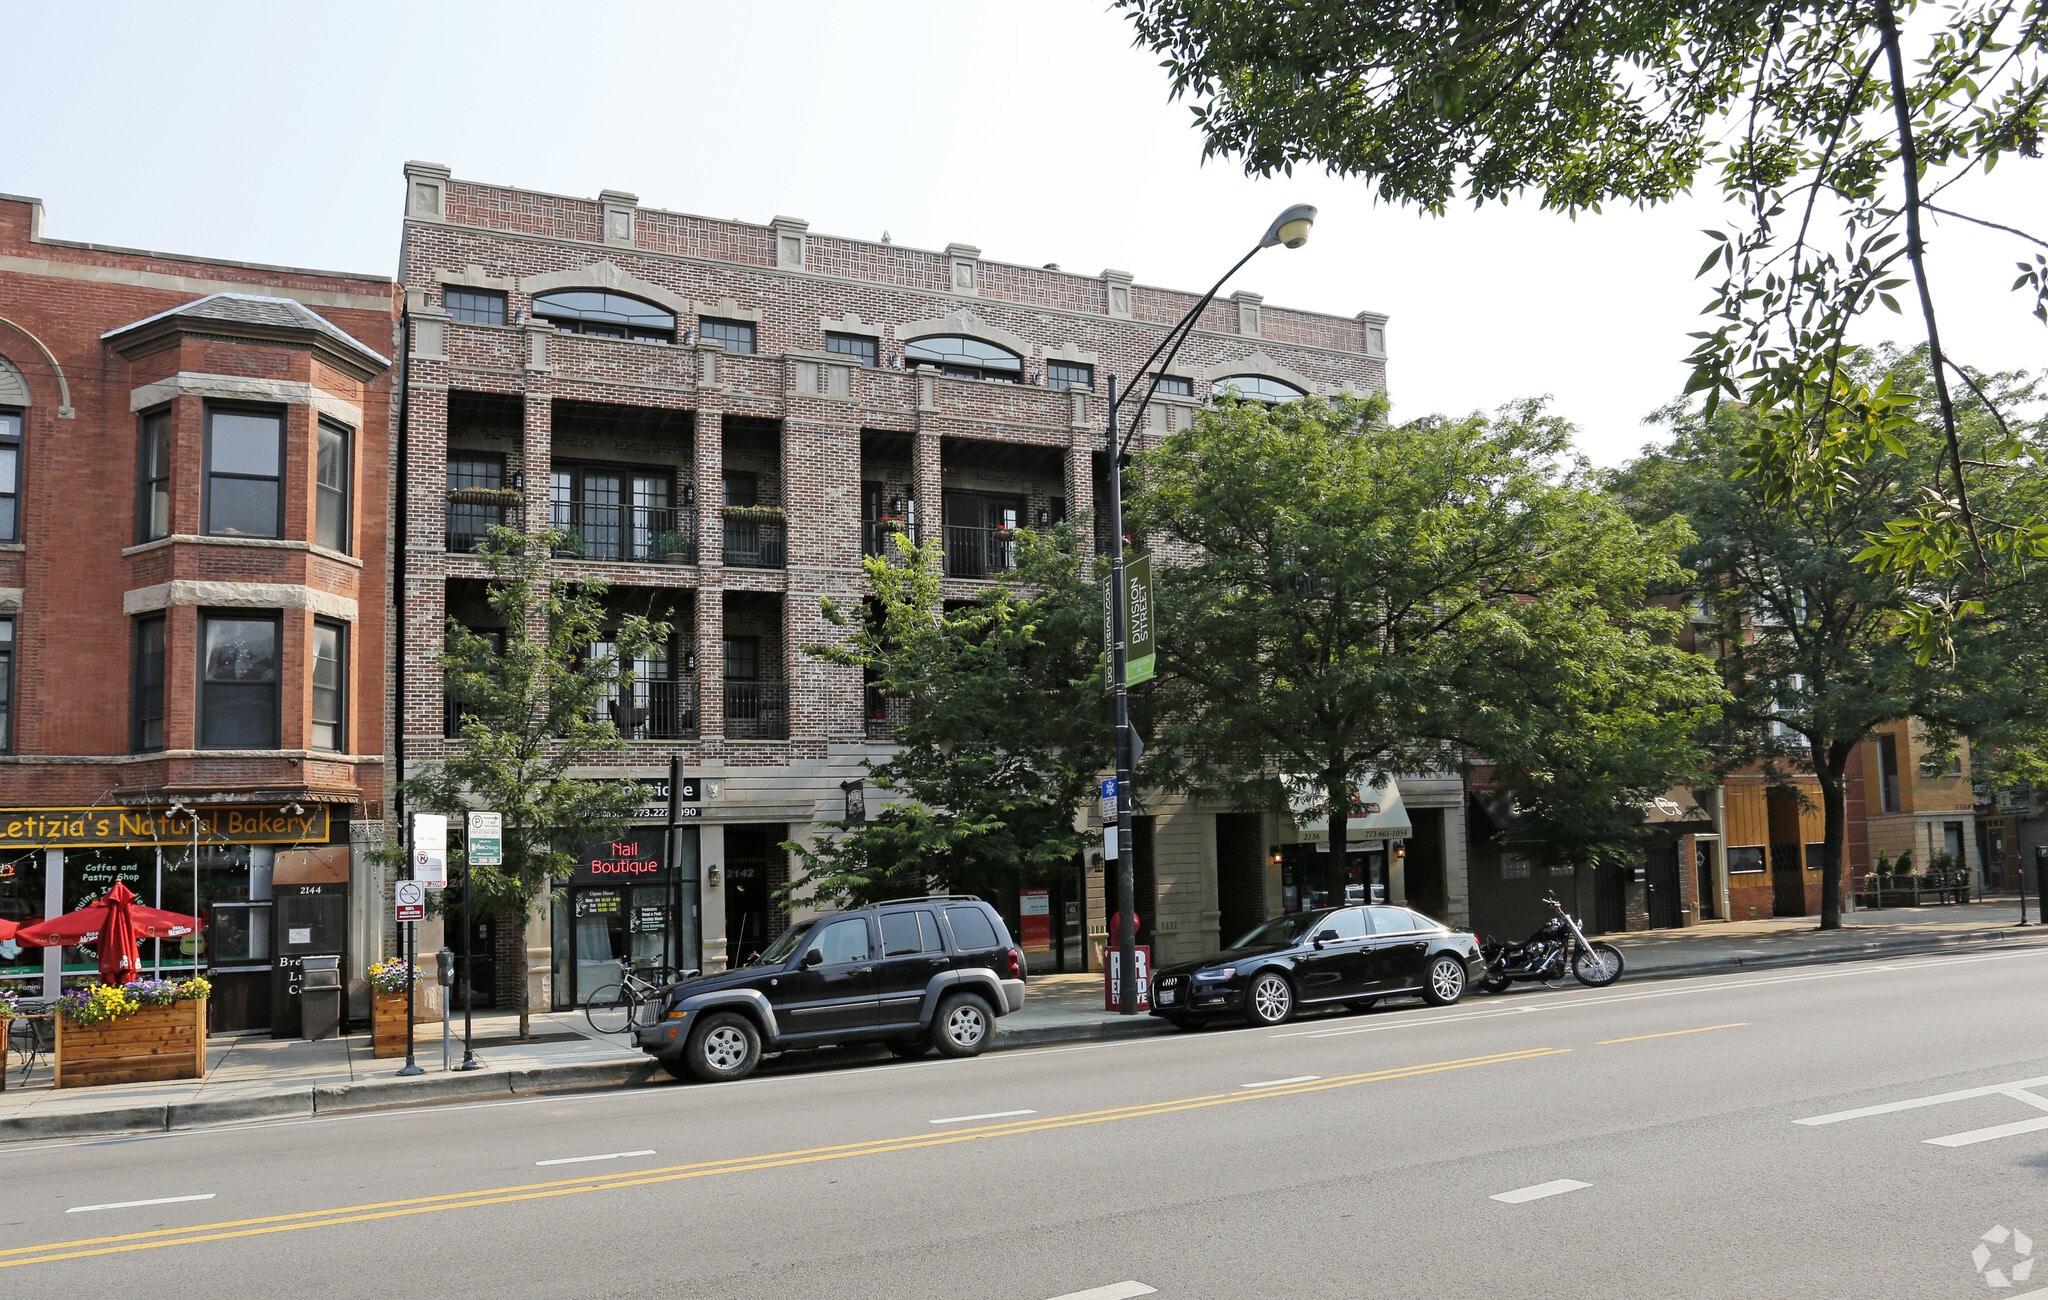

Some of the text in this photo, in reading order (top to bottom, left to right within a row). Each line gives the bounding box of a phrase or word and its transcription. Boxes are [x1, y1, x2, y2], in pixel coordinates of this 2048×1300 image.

[1131, 576, 1140, 644] DIVISION
[1139, 584, 1149, 641] STREET
[1107, 667, 1113, 683] DO
[0, 811, 314, 838] etizia's Natural Bakery
[1365, 829, 1408, 838] 773-661-1054
[612, 841, 638, 856] Nail
[85, 863, 138, 871] Coffee and
[591, 860, 658, 876] Boutique
[726, 868, 754, 878] 2142
[82, 872, 139, 883] Pastry Shop
[300, 886, 321, 894] 2144
